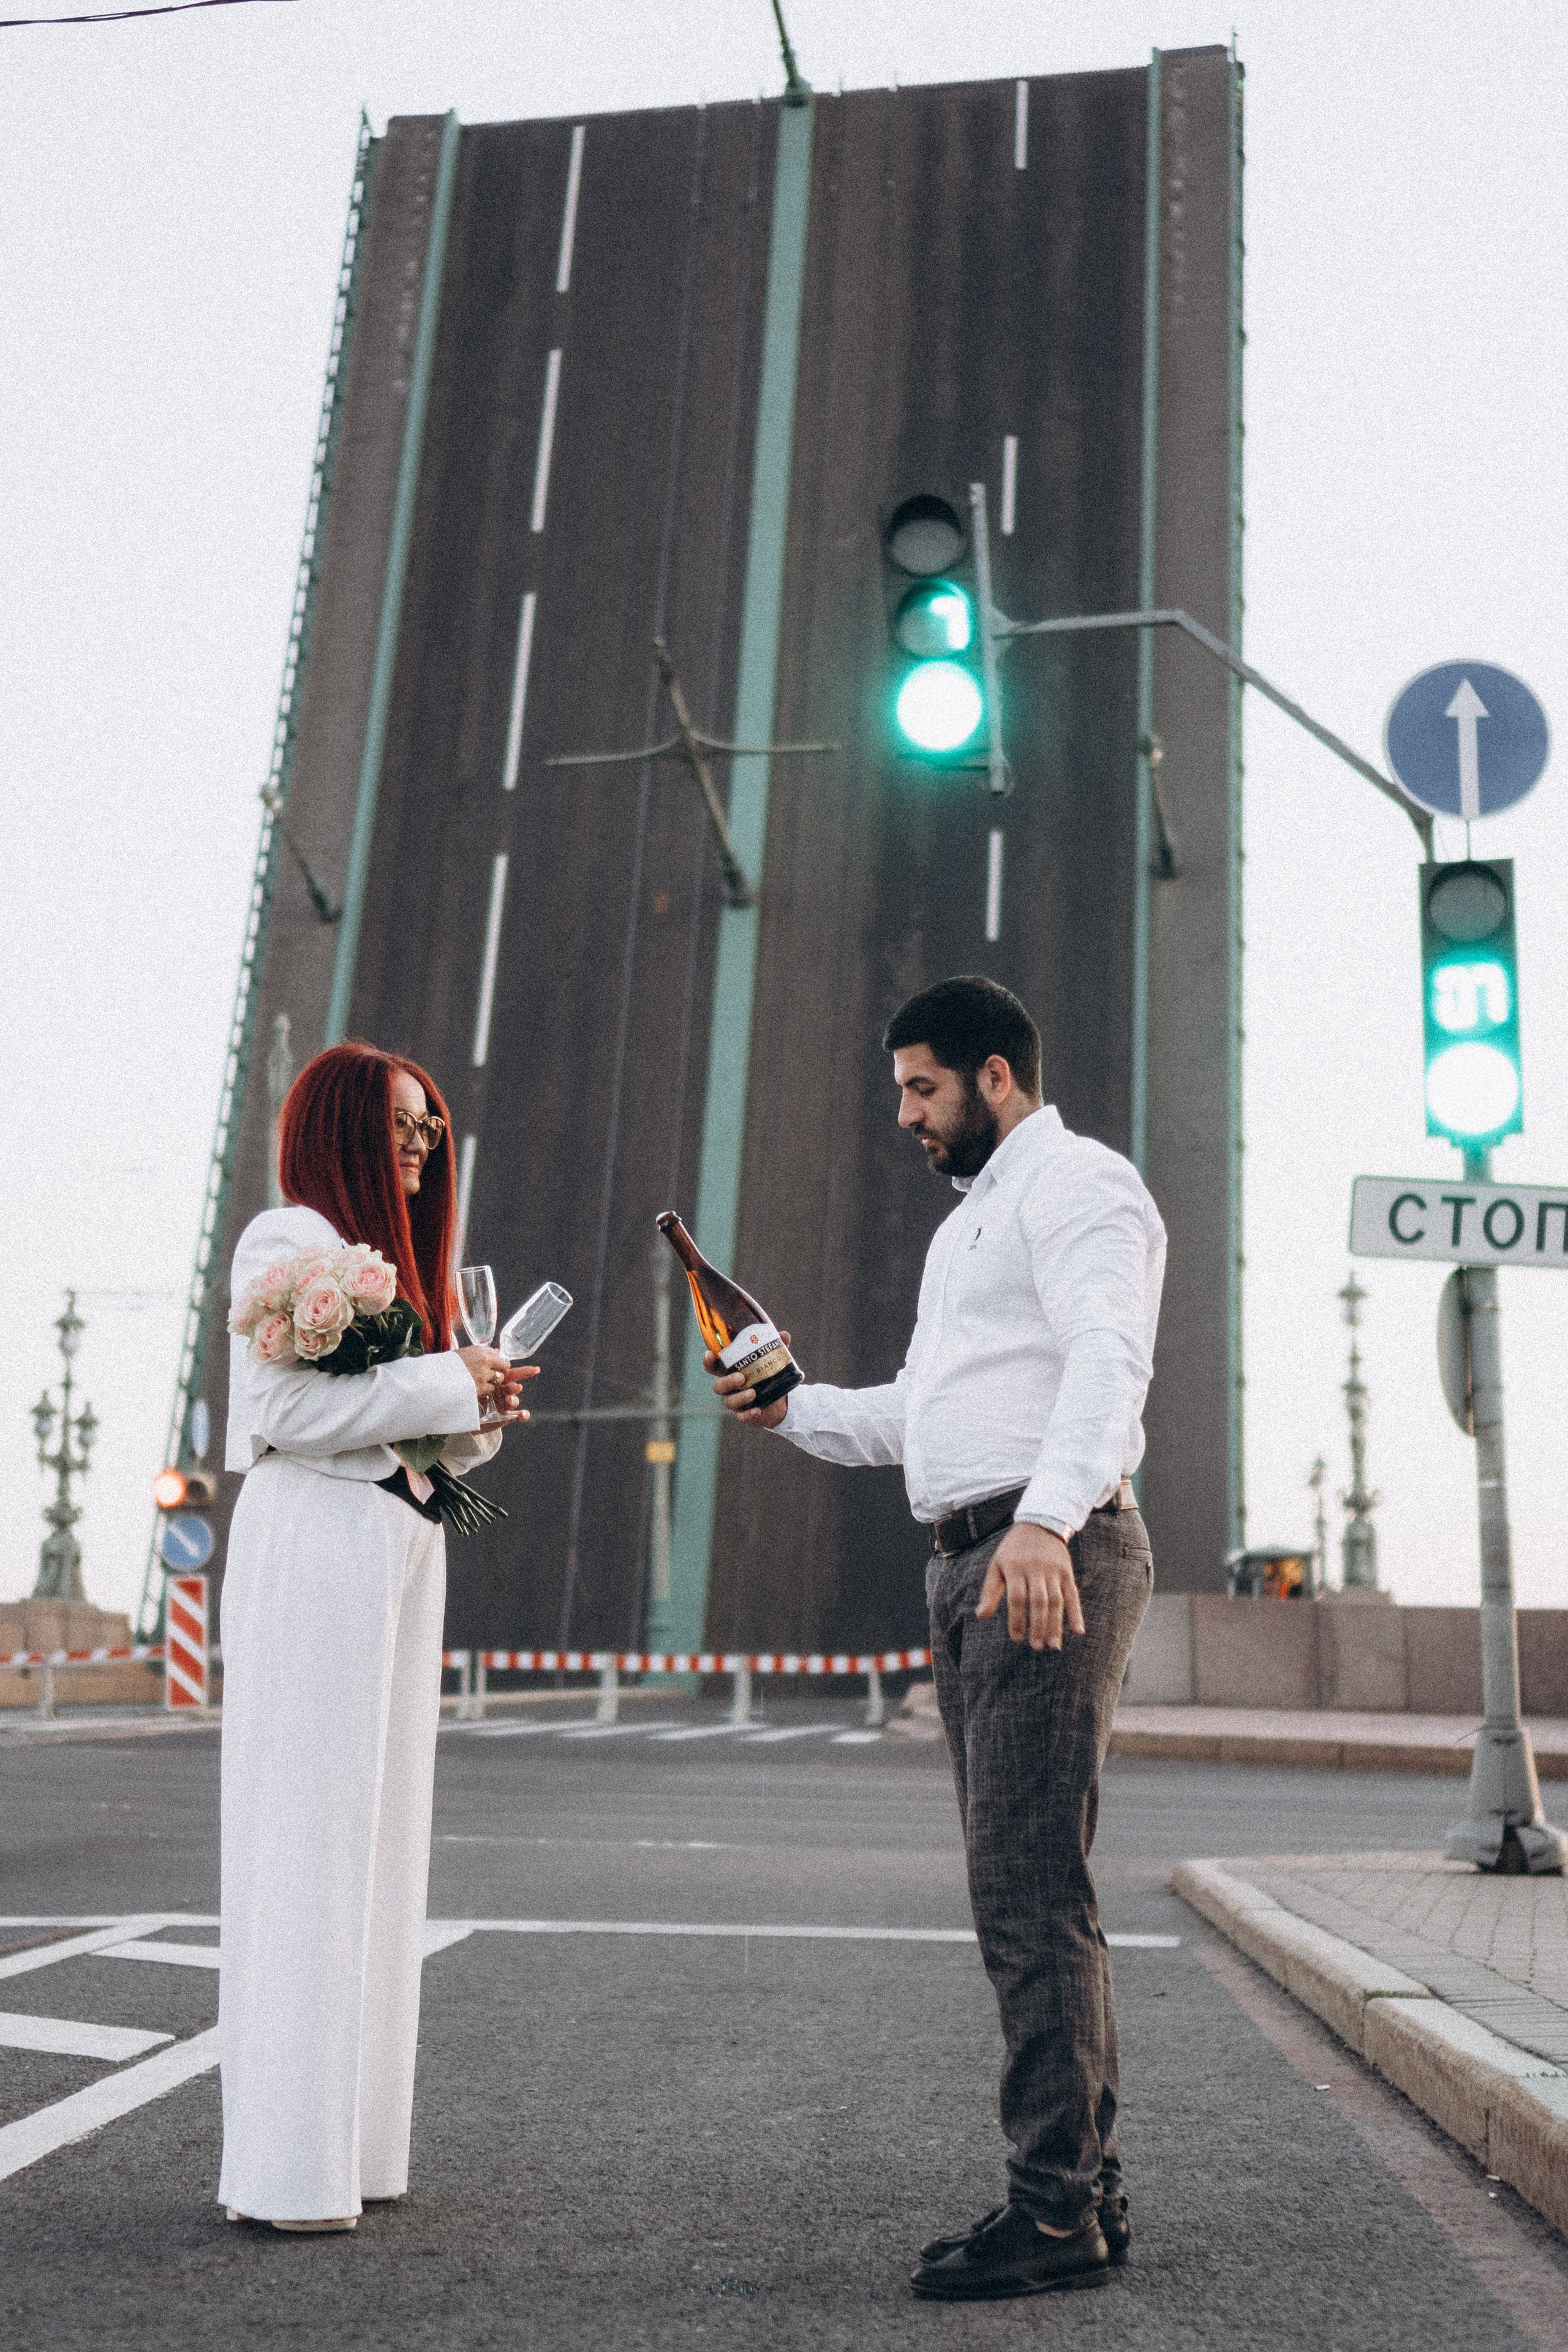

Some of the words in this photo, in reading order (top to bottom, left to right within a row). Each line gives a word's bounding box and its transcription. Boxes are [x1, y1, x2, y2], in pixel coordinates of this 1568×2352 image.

[1388, 1193, 1568, 1253] СТОП
[735, 1352, 758, 1371] SANTO
[758, 1339, 783, 1356] STEFANO
[756, 1356, 782, 1374] BIANCO
